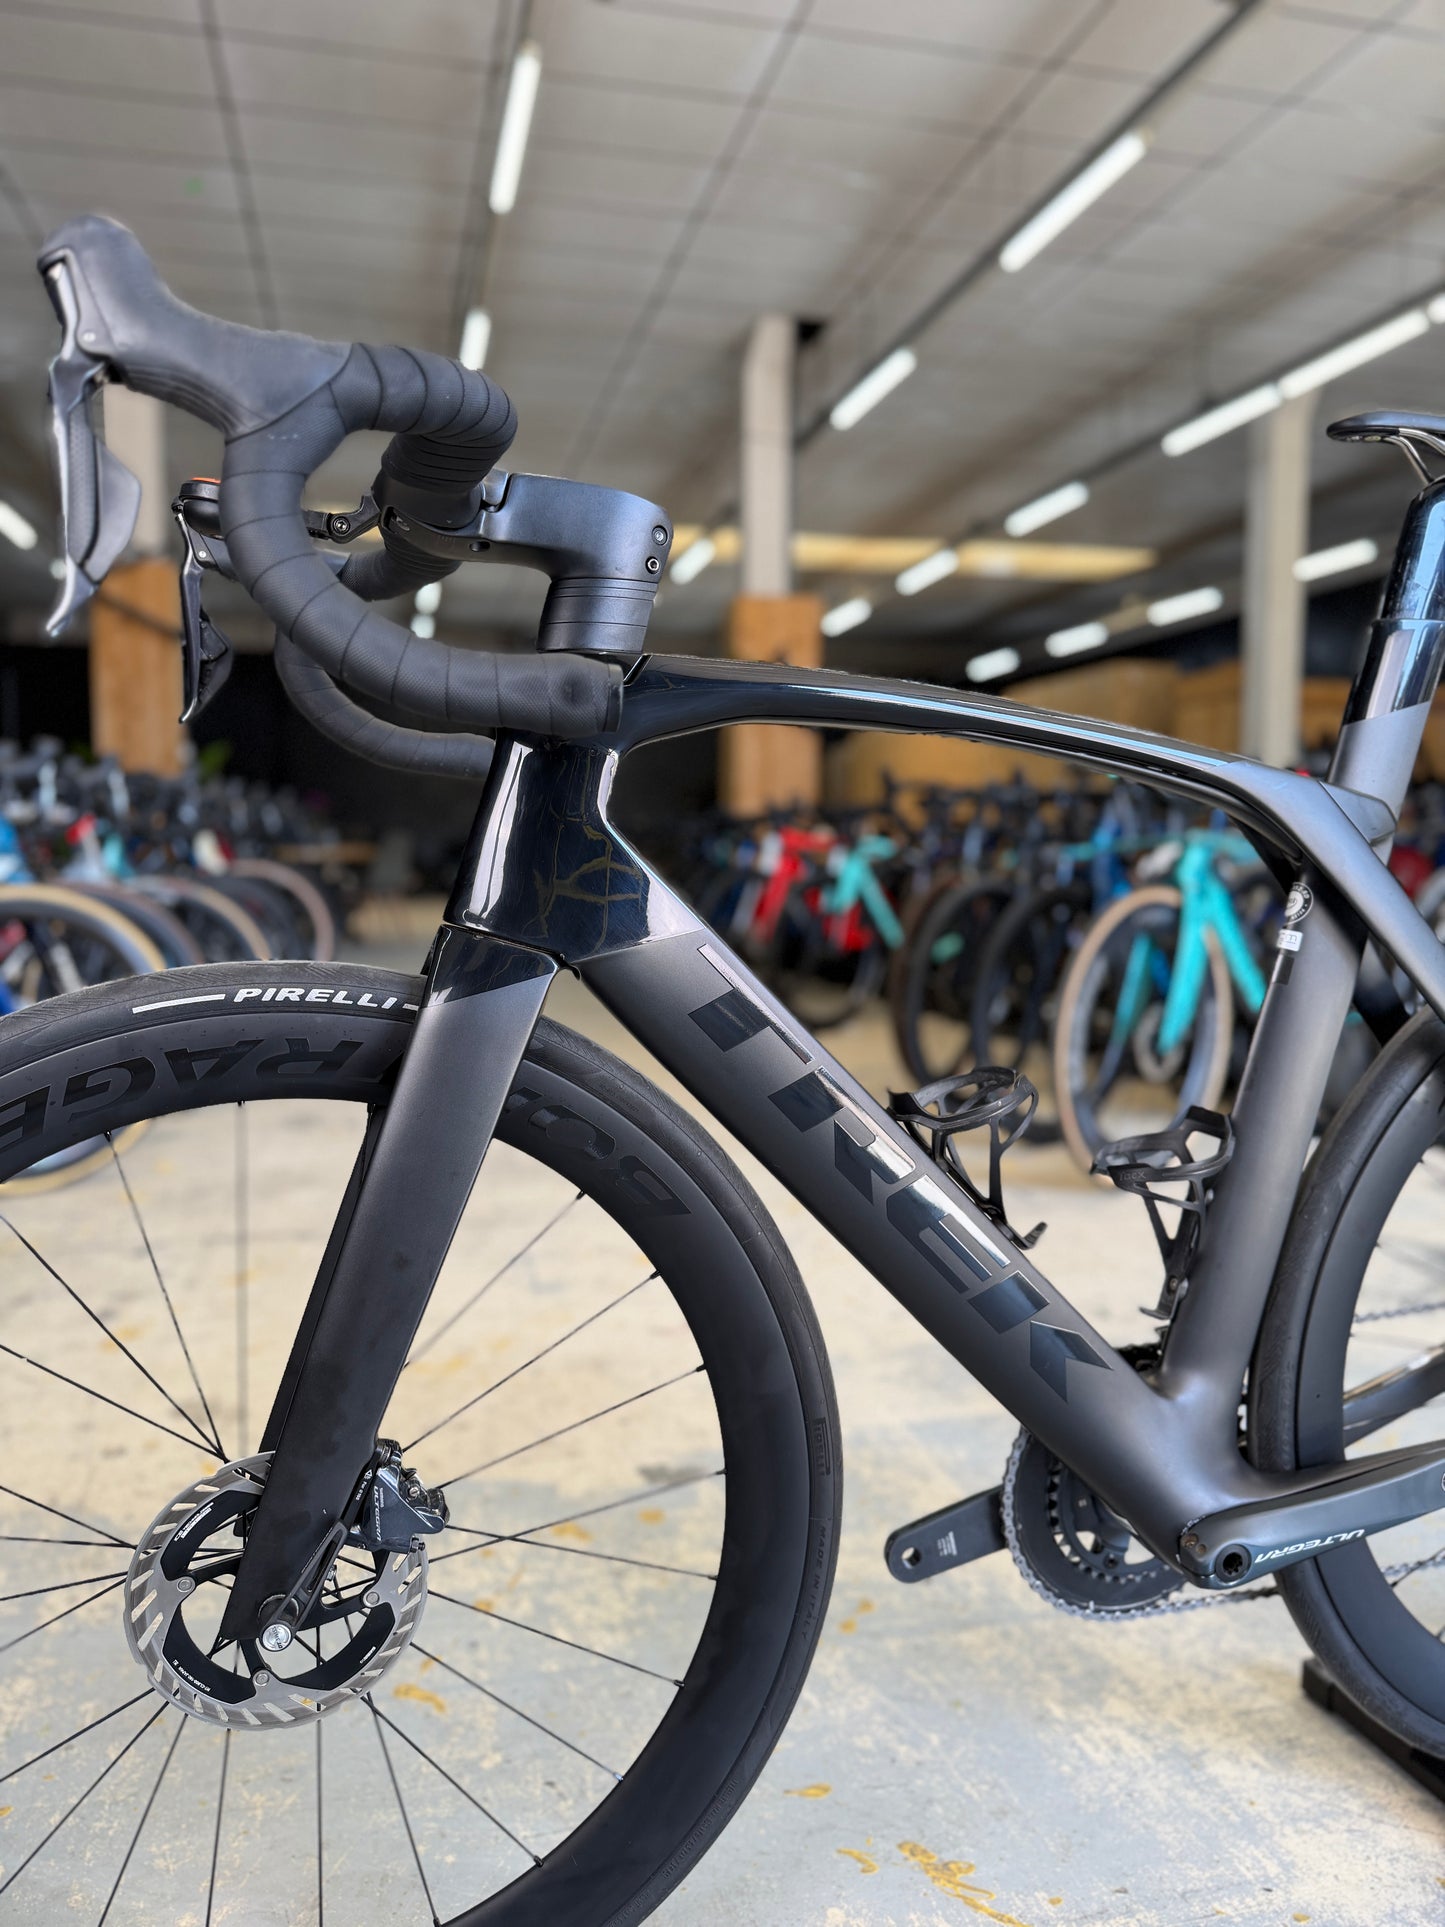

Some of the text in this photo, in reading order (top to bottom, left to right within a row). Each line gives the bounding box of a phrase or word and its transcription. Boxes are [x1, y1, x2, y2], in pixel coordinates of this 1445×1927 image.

[233, 987, 398, 1012] PIRELLI
[688, 944, 1113, 1403] TREK
[373, 1485, 382, 1542] ULTEGRA
[1254, 1529, 1366, 1564] ULTEGRA
[801, 1526, 826, 1640] MADE IN ITALY
